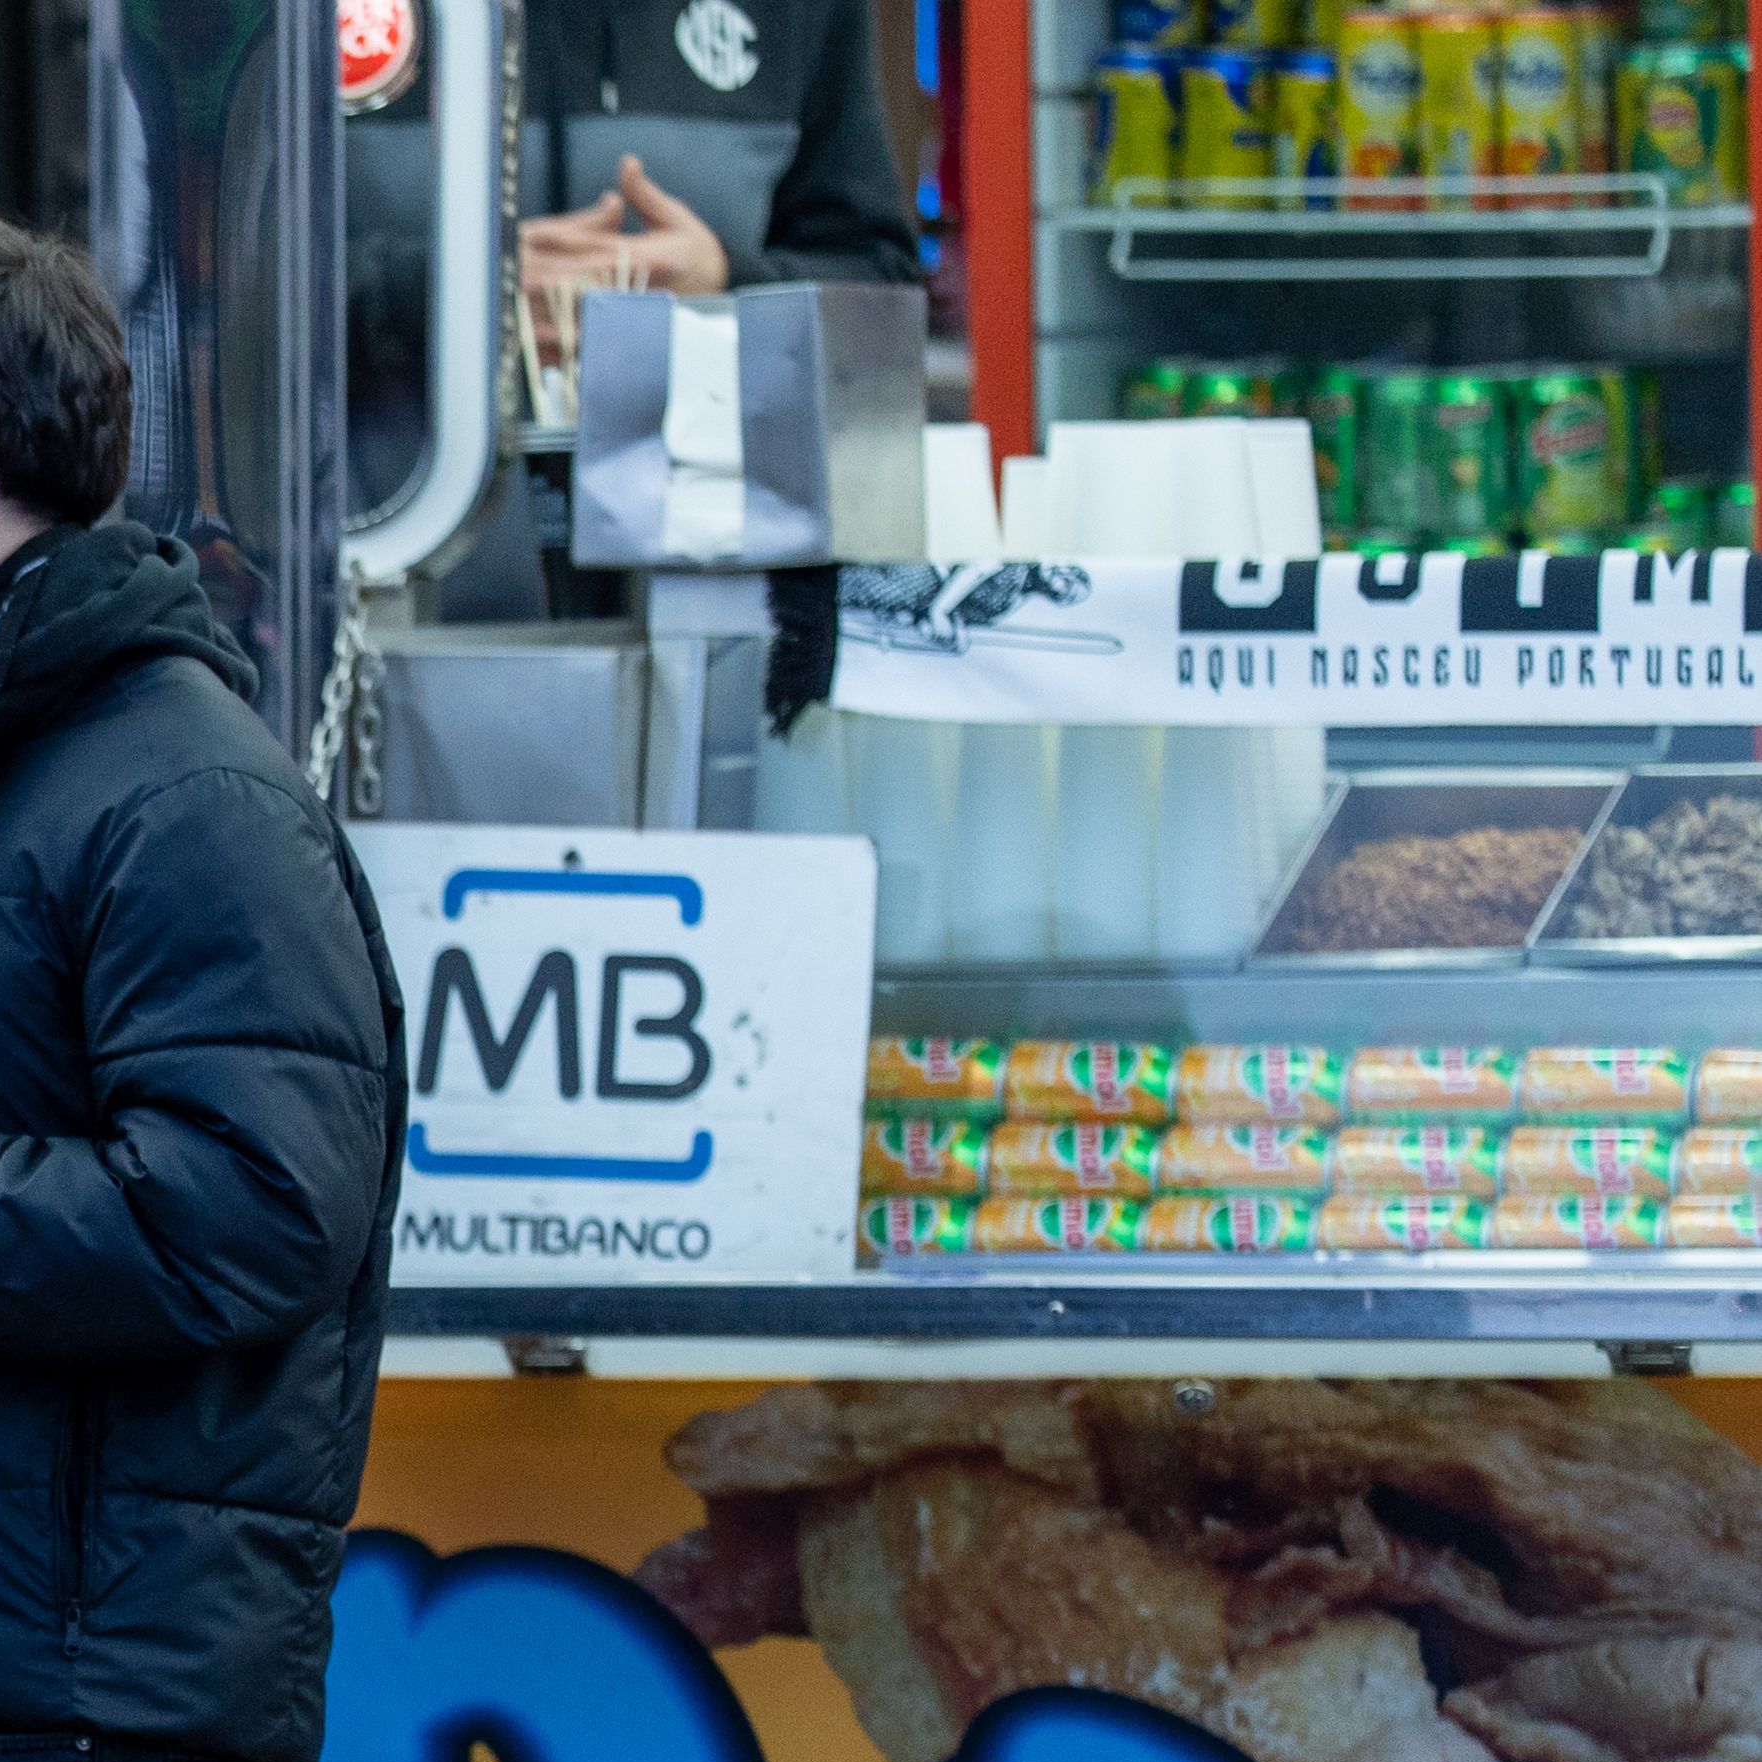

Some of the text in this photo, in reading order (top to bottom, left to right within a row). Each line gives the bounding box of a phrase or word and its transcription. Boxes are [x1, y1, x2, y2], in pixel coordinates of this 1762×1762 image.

[1176, 644, 1757, 694] AQUI NASCEU PORTUGAL
[415, 945, 714, 1101] MB
[398, 1211, 713, 1261] MULTIBANCO
